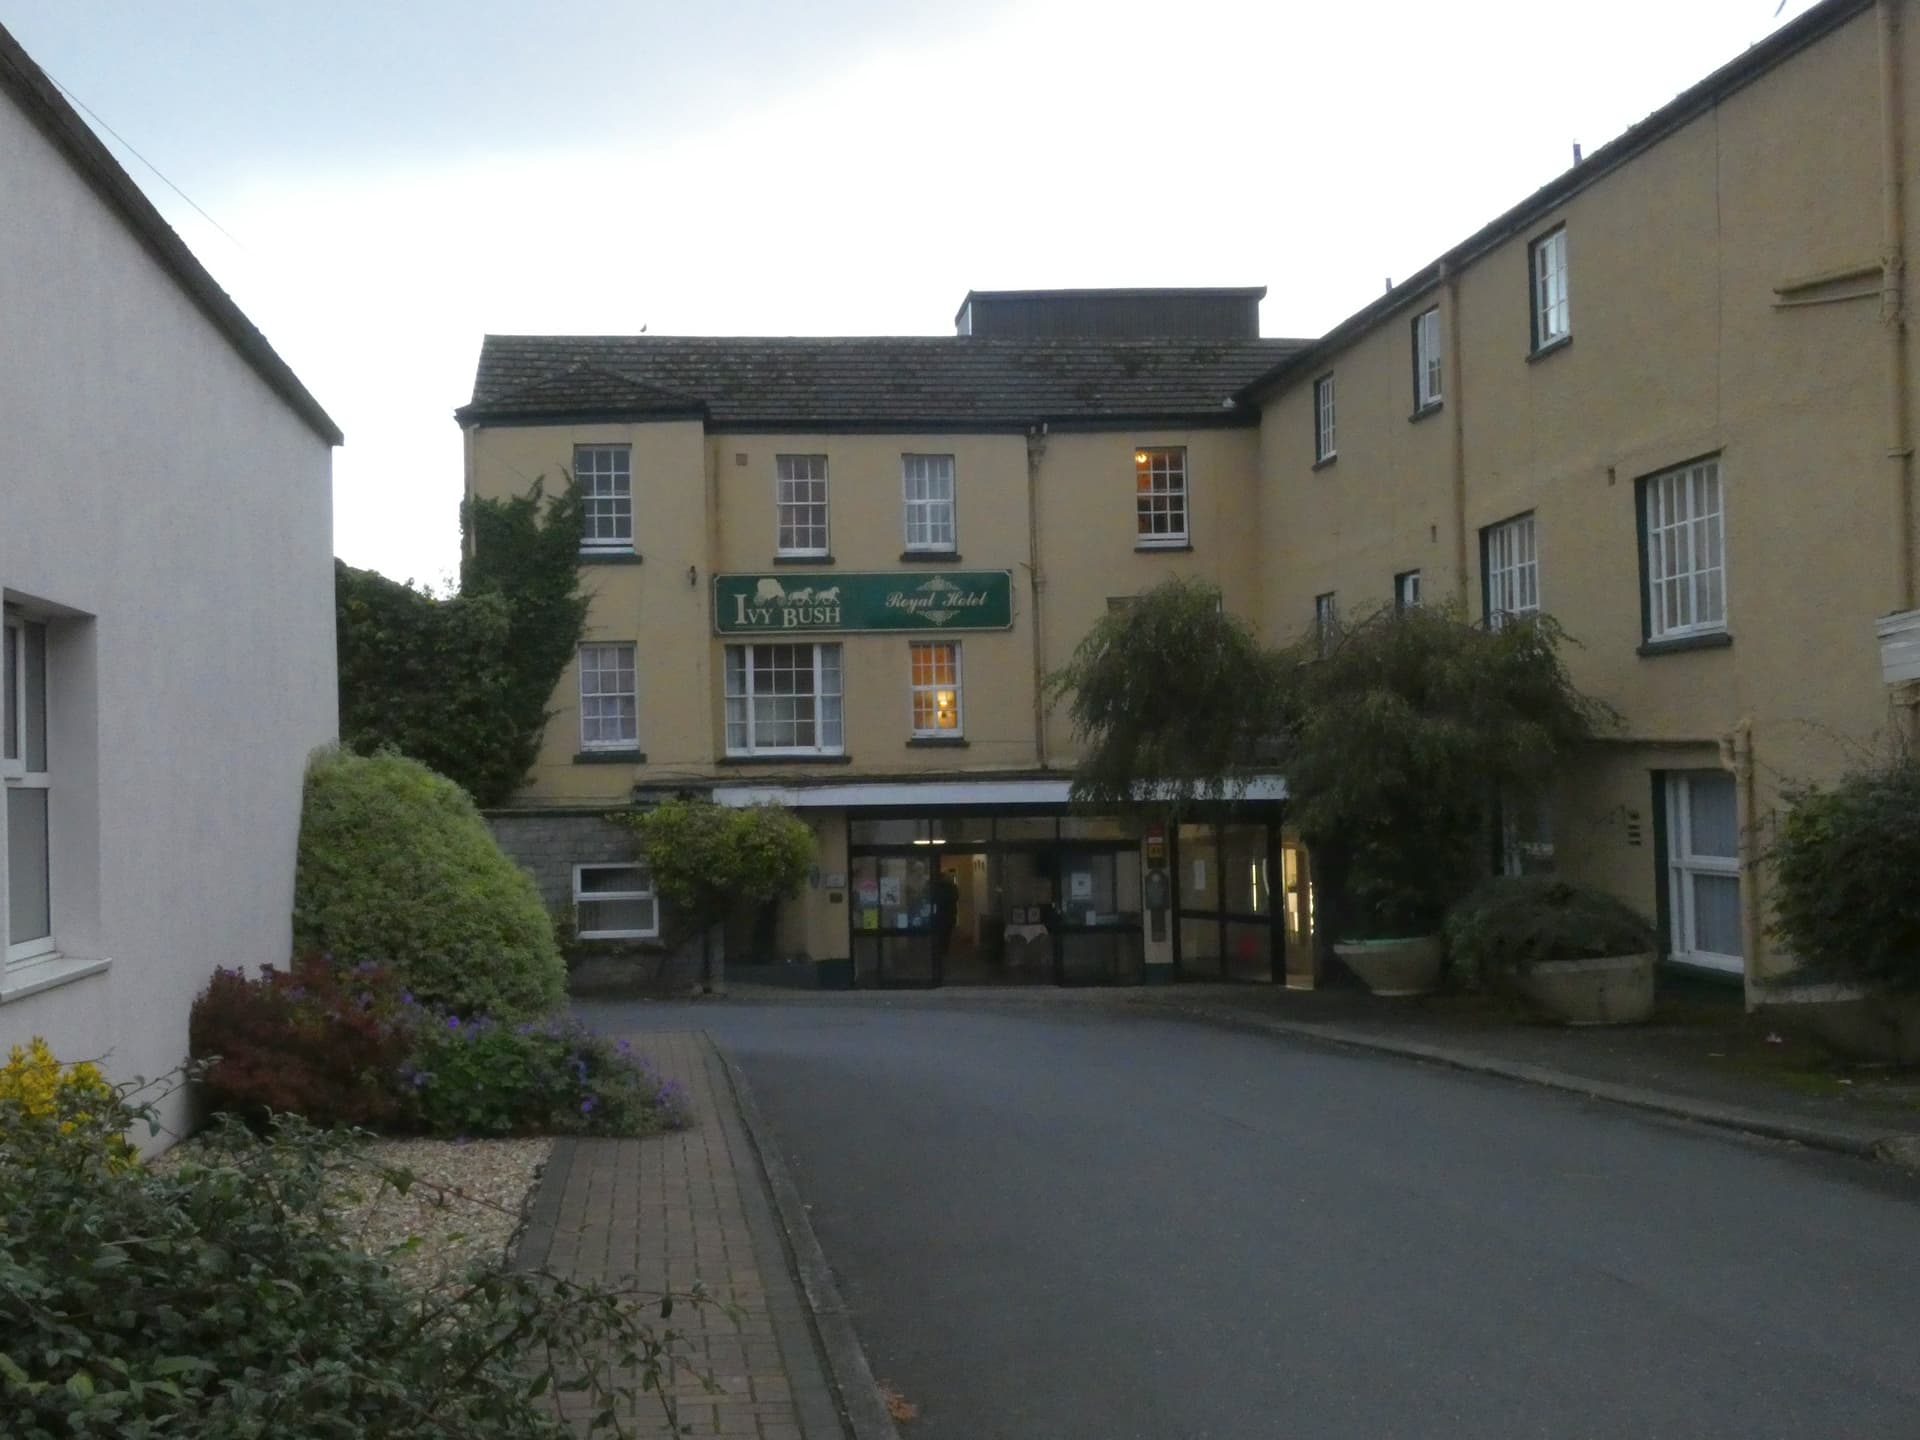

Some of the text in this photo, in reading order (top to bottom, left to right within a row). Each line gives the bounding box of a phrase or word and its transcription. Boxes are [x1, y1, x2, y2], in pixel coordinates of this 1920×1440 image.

[885, 591, 987, 614] Royal Hotel
[782, 606, 841, 628] BUSH
